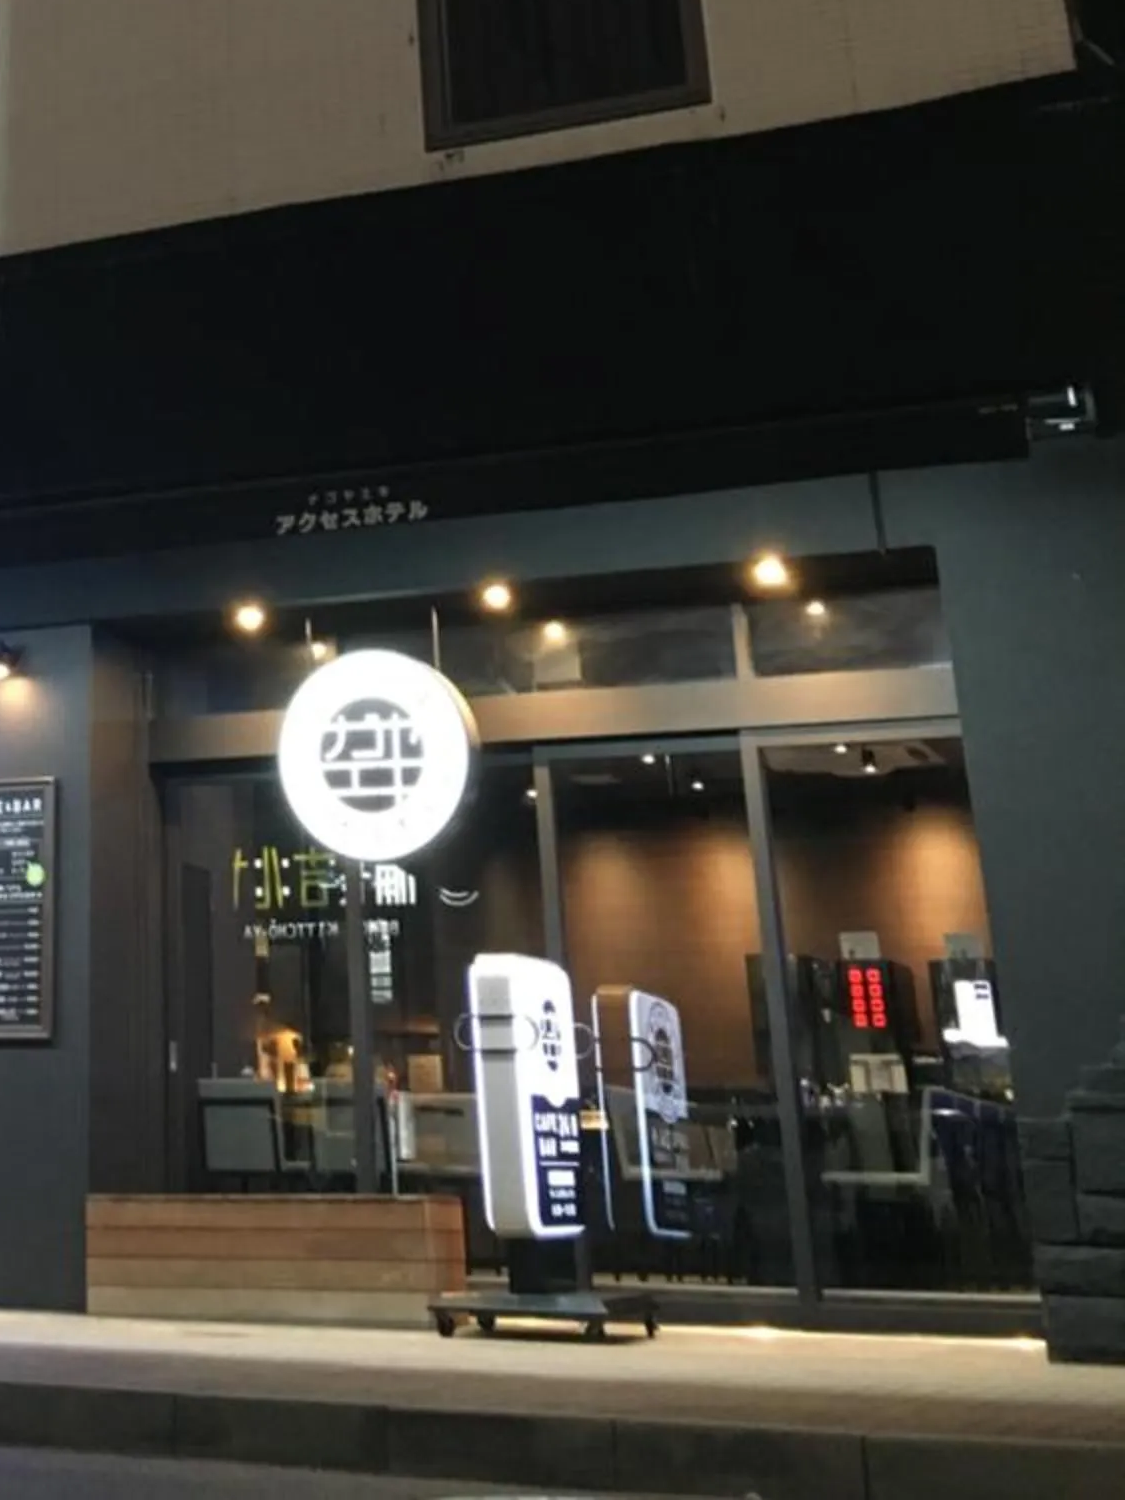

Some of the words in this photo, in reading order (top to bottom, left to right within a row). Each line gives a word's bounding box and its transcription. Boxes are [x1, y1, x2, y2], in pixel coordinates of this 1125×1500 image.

[276, 499, 428, 536] アクセスホテル
